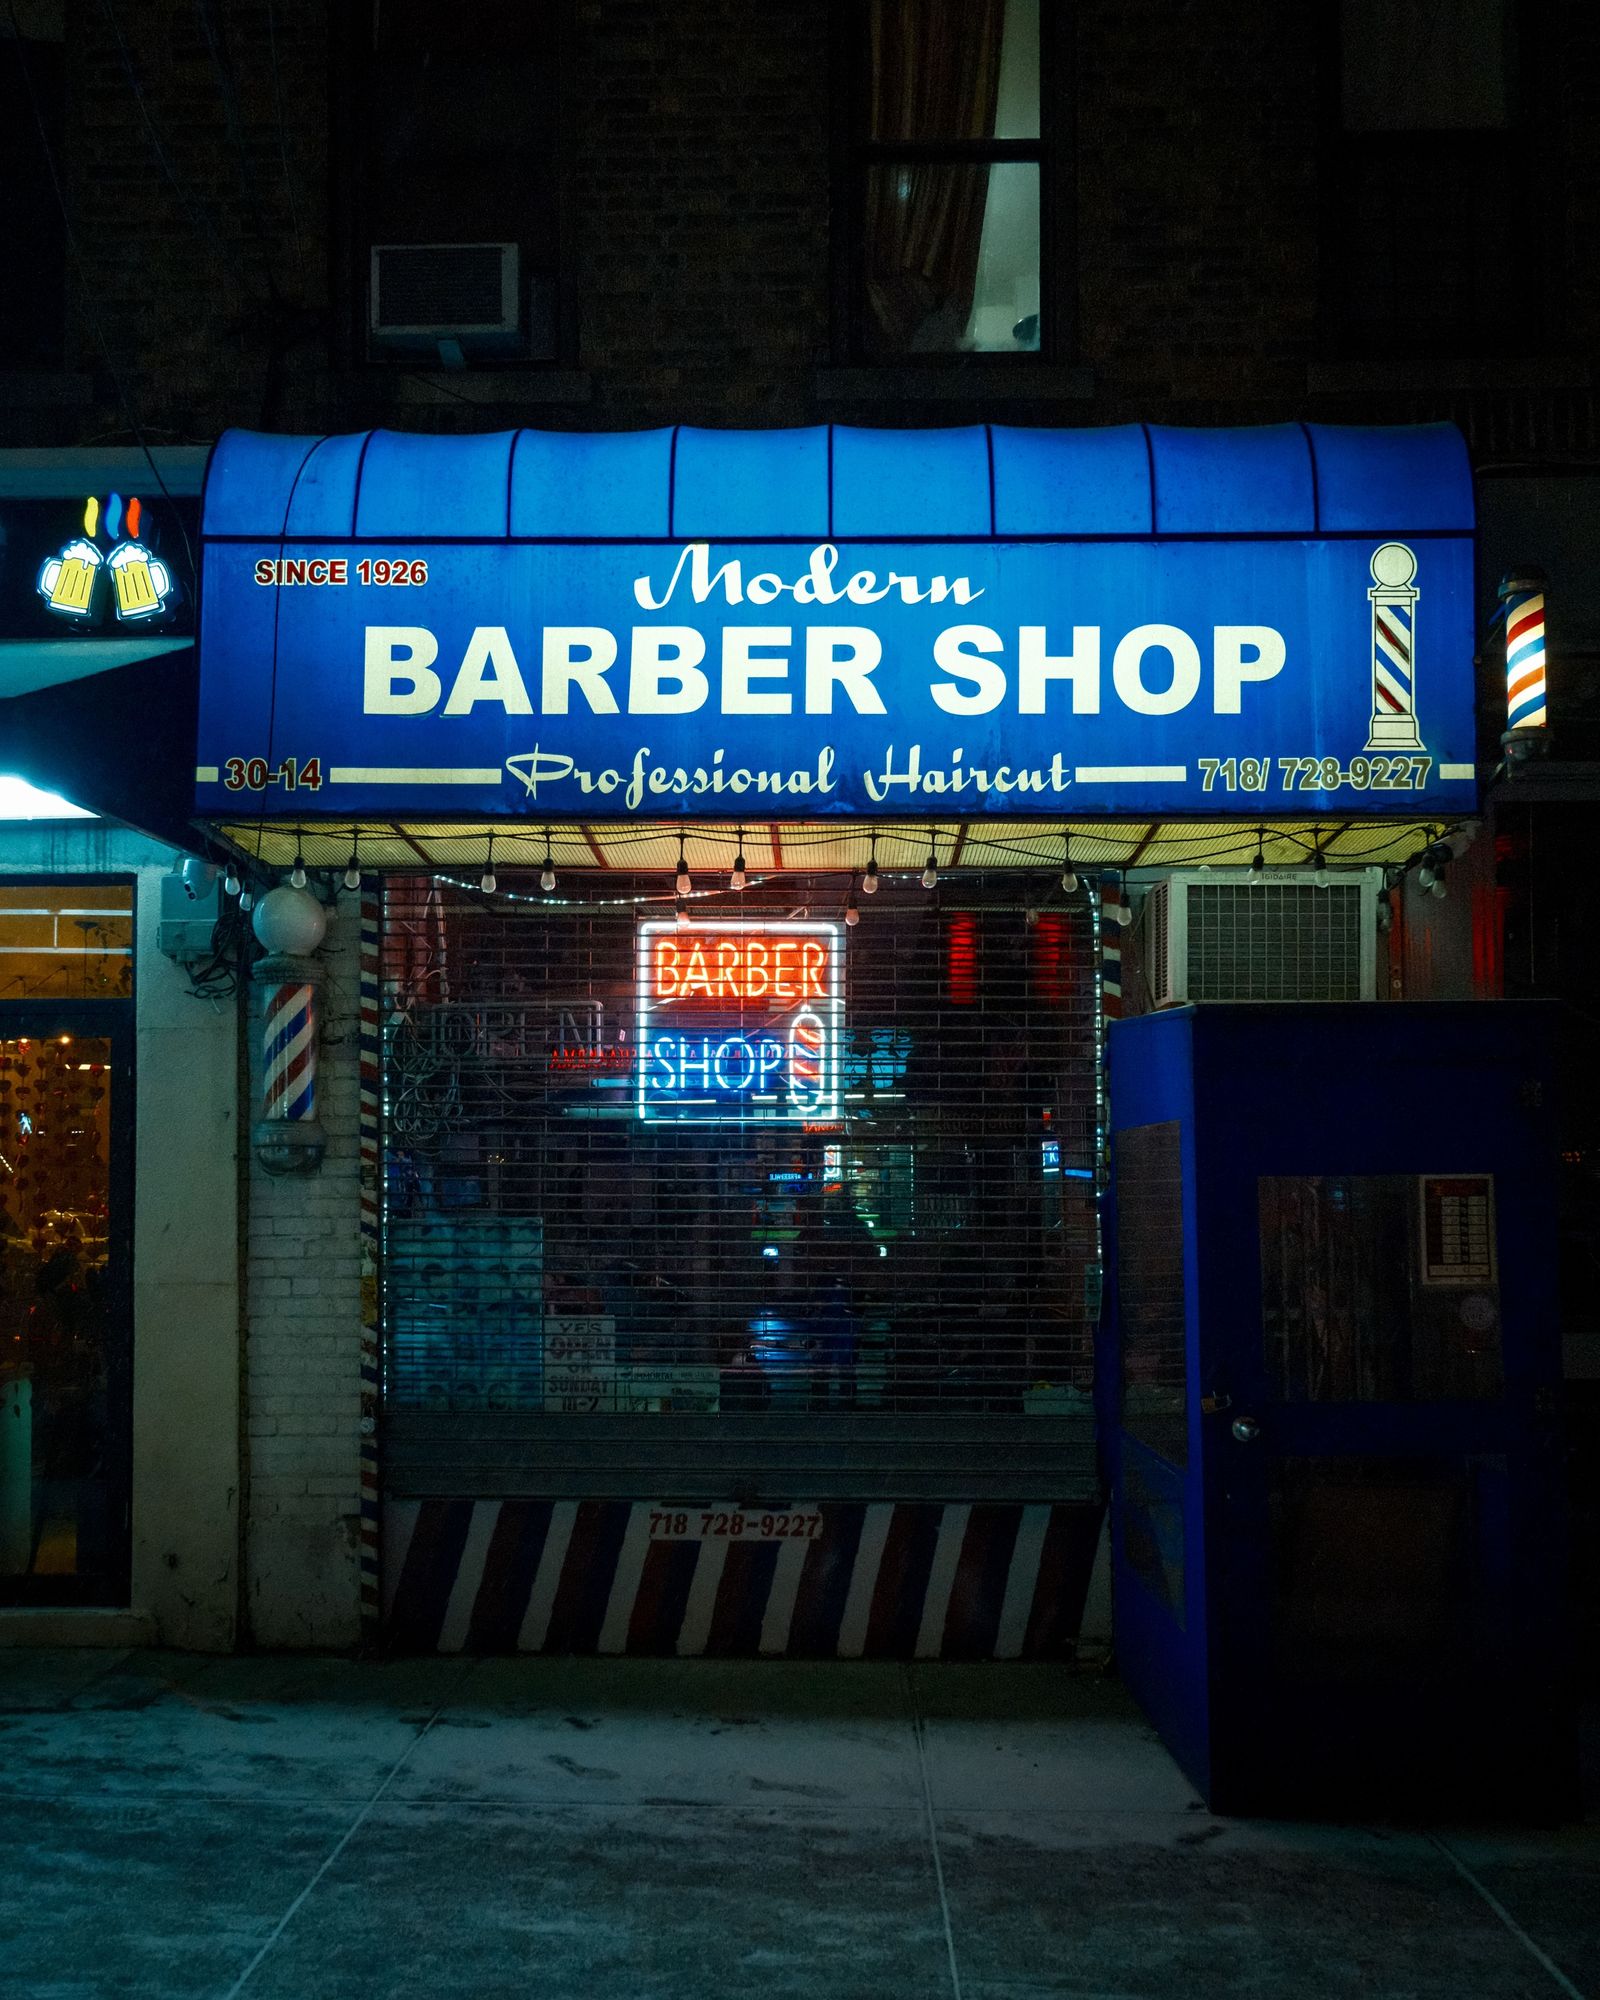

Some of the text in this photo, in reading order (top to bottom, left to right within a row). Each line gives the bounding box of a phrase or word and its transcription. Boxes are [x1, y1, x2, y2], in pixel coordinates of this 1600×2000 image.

[254, 558, 429, 586] SINCE 1926
[634, 543, 985, 610] Modern
[363, 623, 1287, 716] BARBER SHOP
[223, 757, 324, 792] 30-14
[505, 742, 1072, 810] Professional Haircut
[1198, 756, 1433, 792] 718/ 728-9227
[656, 941, 830, 997] BARBER
[652, 1036, 782, 1092] SHOP
[649, 1512, 821, 1538] 718 728-9227
